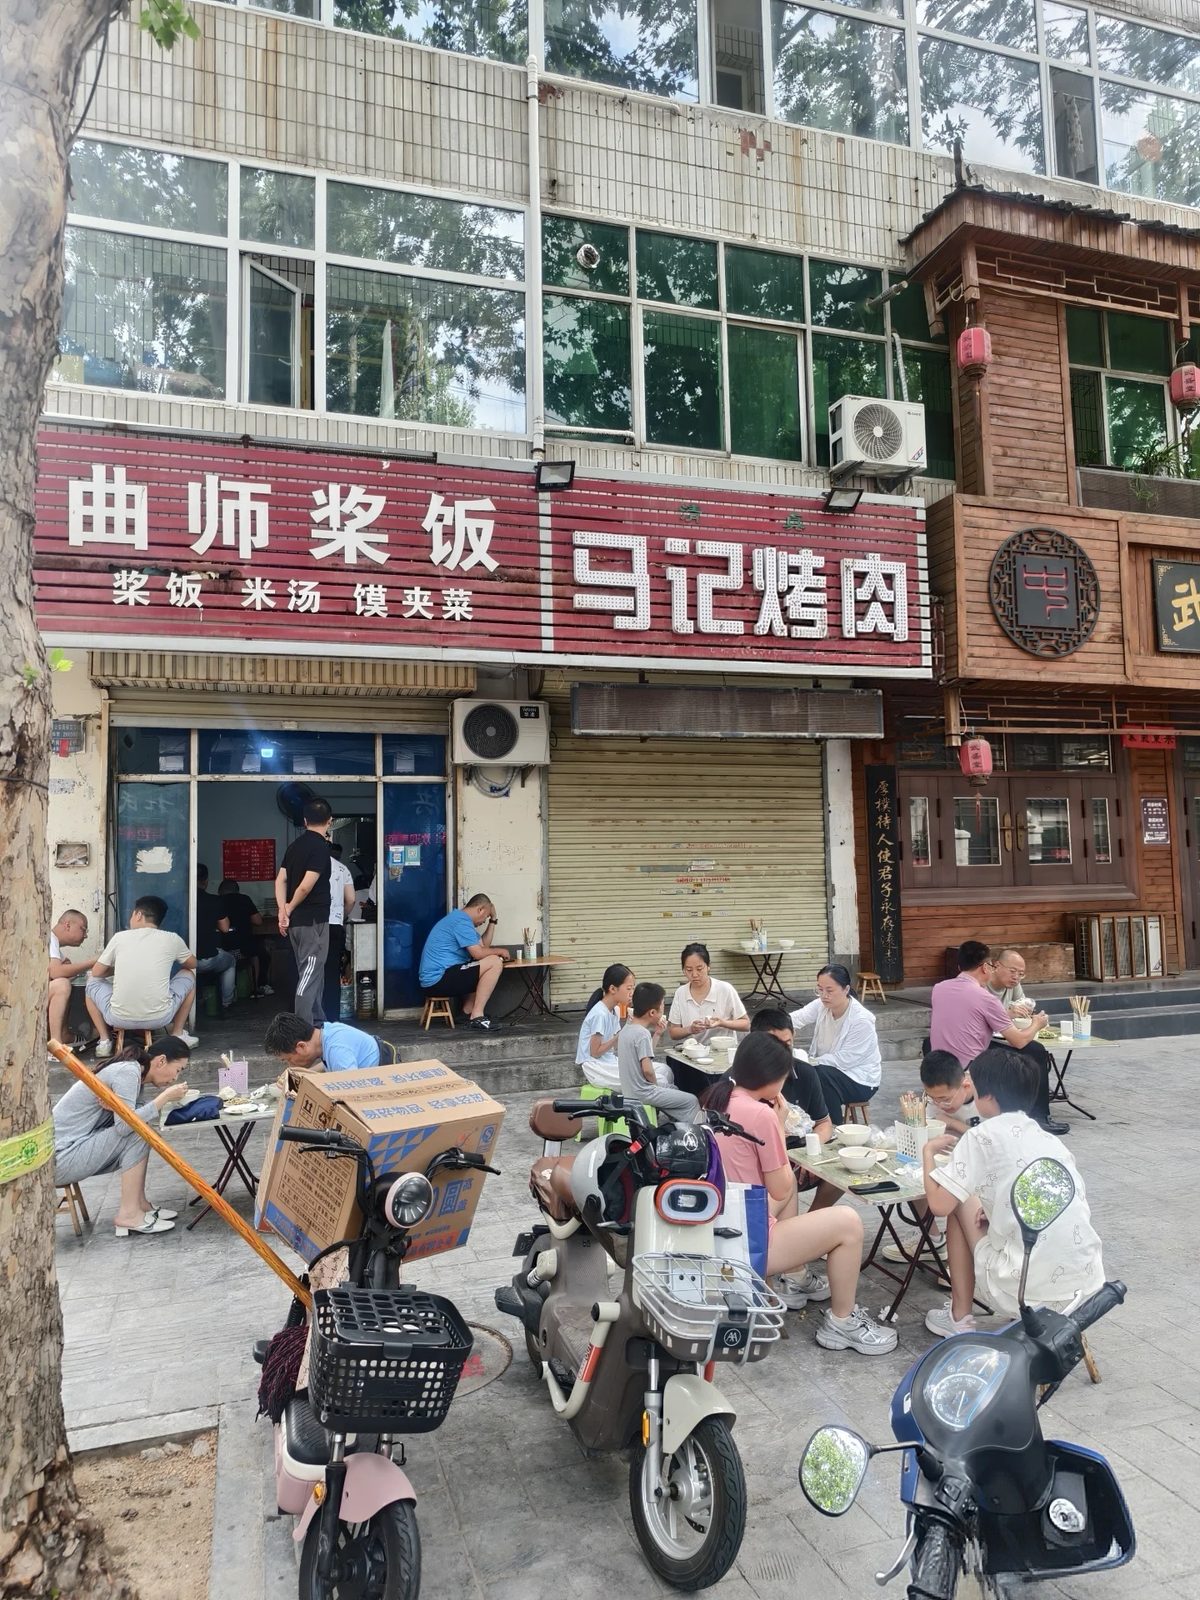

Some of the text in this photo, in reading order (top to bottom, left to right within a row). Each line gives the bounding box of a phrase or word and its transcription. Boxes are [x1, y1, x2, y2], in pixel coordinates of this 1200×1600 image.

[68, 464, 501, 572] 曲师桨饭
[240, 577, 321, 613] 米汤
[353, 583, 474, 621] 馍夹菜
[572, 531, 909, 641] 马记烤肉
